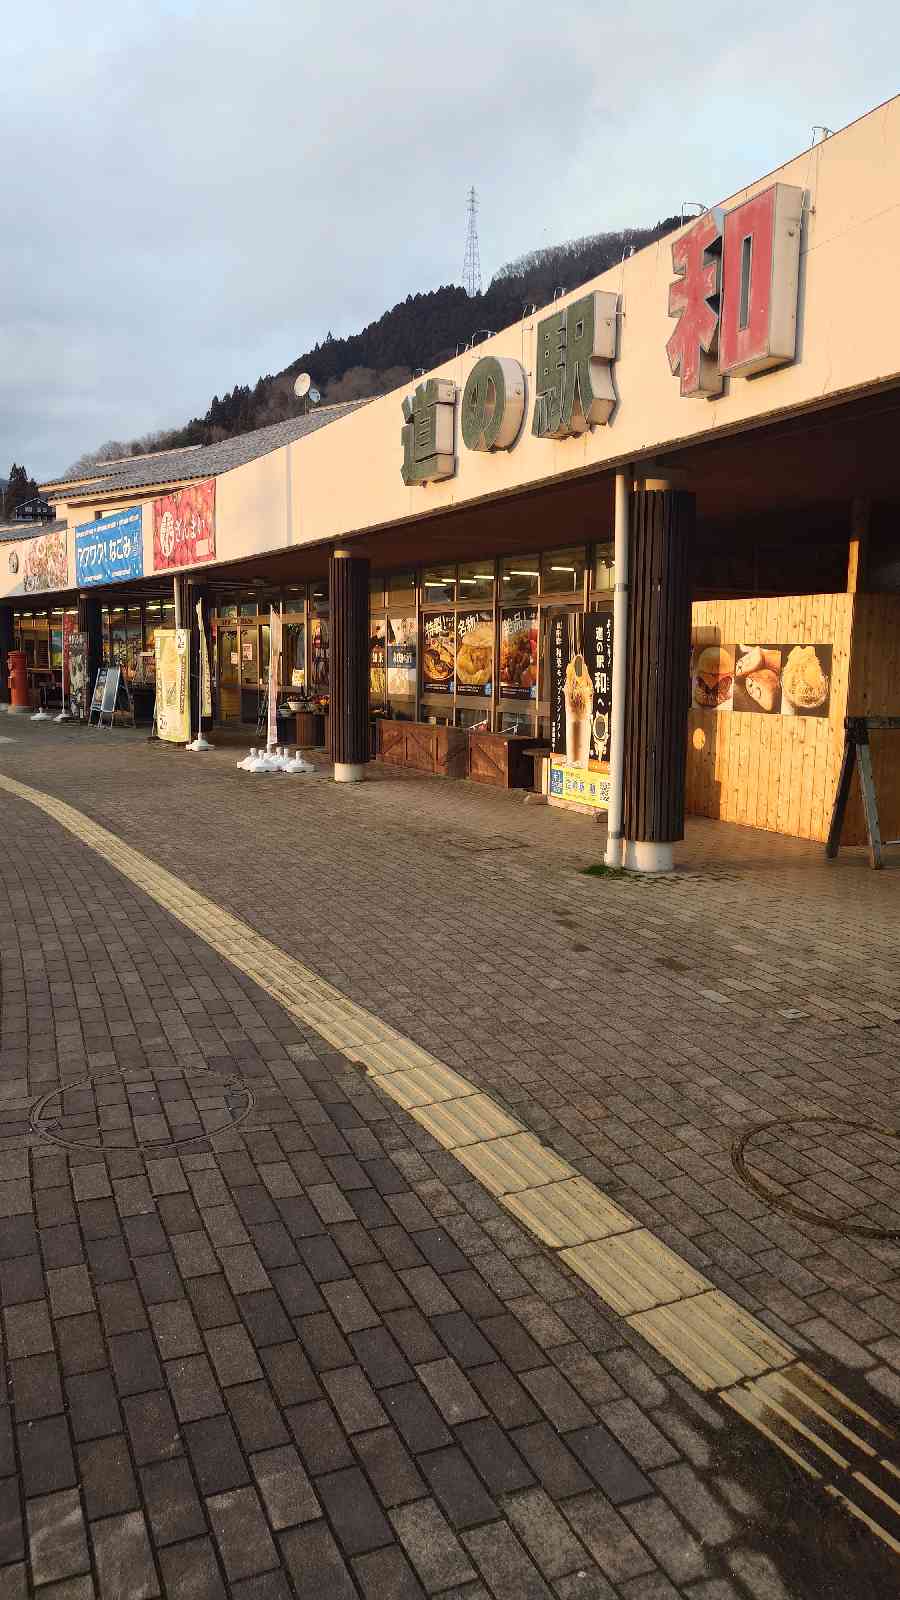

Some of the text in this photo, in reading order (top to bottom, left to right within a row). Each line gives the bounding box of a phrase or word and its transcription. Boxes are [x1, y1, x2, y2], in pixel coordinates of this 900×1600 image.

[401, 183, 803, 486] 道の駅 和
